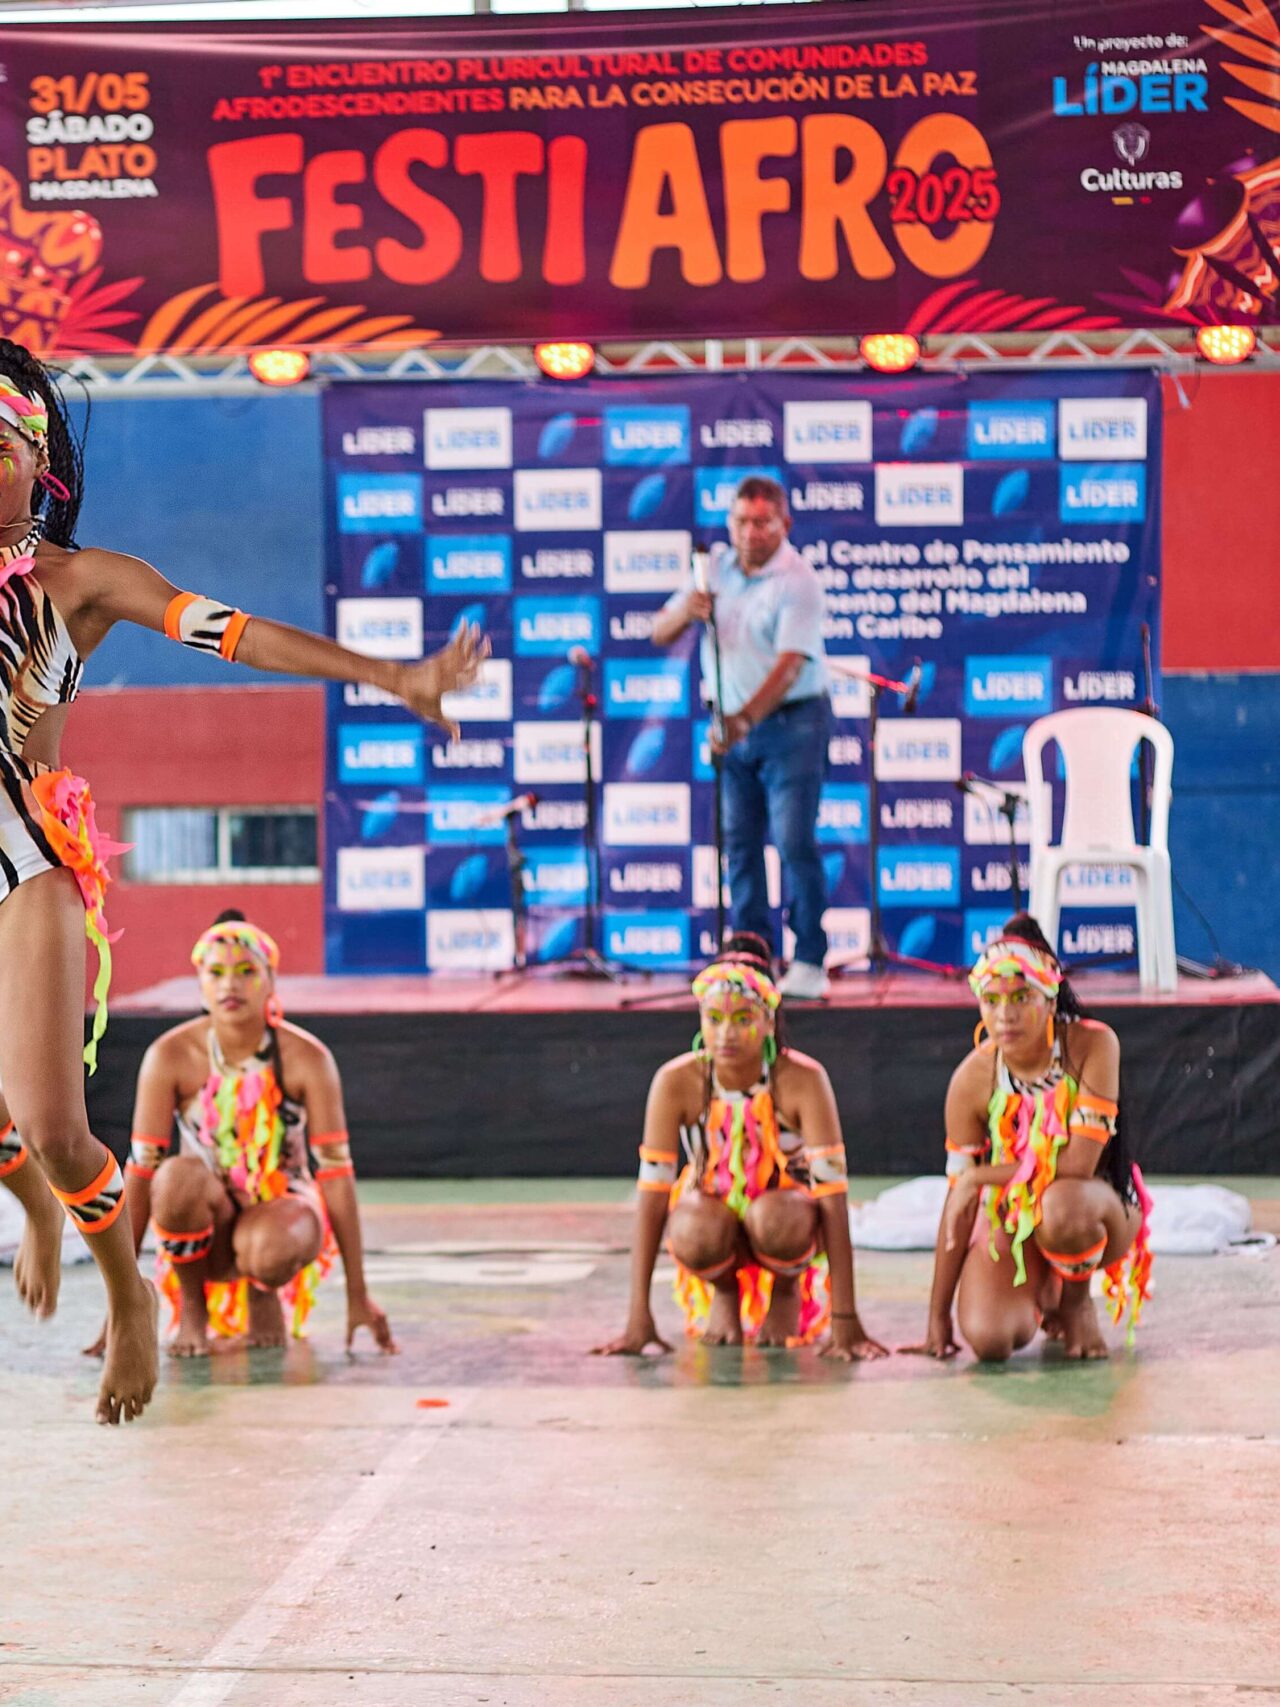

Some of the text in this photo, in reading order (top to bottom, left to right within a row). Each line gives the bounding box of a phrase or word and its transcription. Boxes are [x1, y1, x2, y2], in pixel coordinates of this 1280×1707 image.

[287, 59, 452, 88] ENCUENTRO
[458, 53, 675, 83] PLURICULTURAL
[685, 51, 723, 73] DE
[727, 42, 928, 72] COMUNIDADES
[1101, 59, 1208, 77] MAGDALENA
[29, 71, 150, 114] 31/05
[212, 70, 978, 121] AFRODESCENDIENTES PARA LA CONSECUCIÓN DE LA PAZ
[1052, 62, 1209, 116] LÍDER
[26, 109, 154, 144] SÁBADO
[27, 144, 157, 180] PLATO
[1080, 167, 1183, 192] Culturas
[29, 178, 159, 201] MAGDALENA
[608, 112, 995, 289] AFRO
[887, 167, 1001, 224] 2025
[832, 539, 919, 565] Centro
[923, 539, 958, 565] de
[962, 538, 1130, 564] Pensamiento
[852, 564, 984, 590] desarrollo
[987, 563, 1030, 589] del
[898, 588, 942, 614] del
[946, 587, 1087, 618] Magdalena
[856, 614, 943, 641] Caribe
